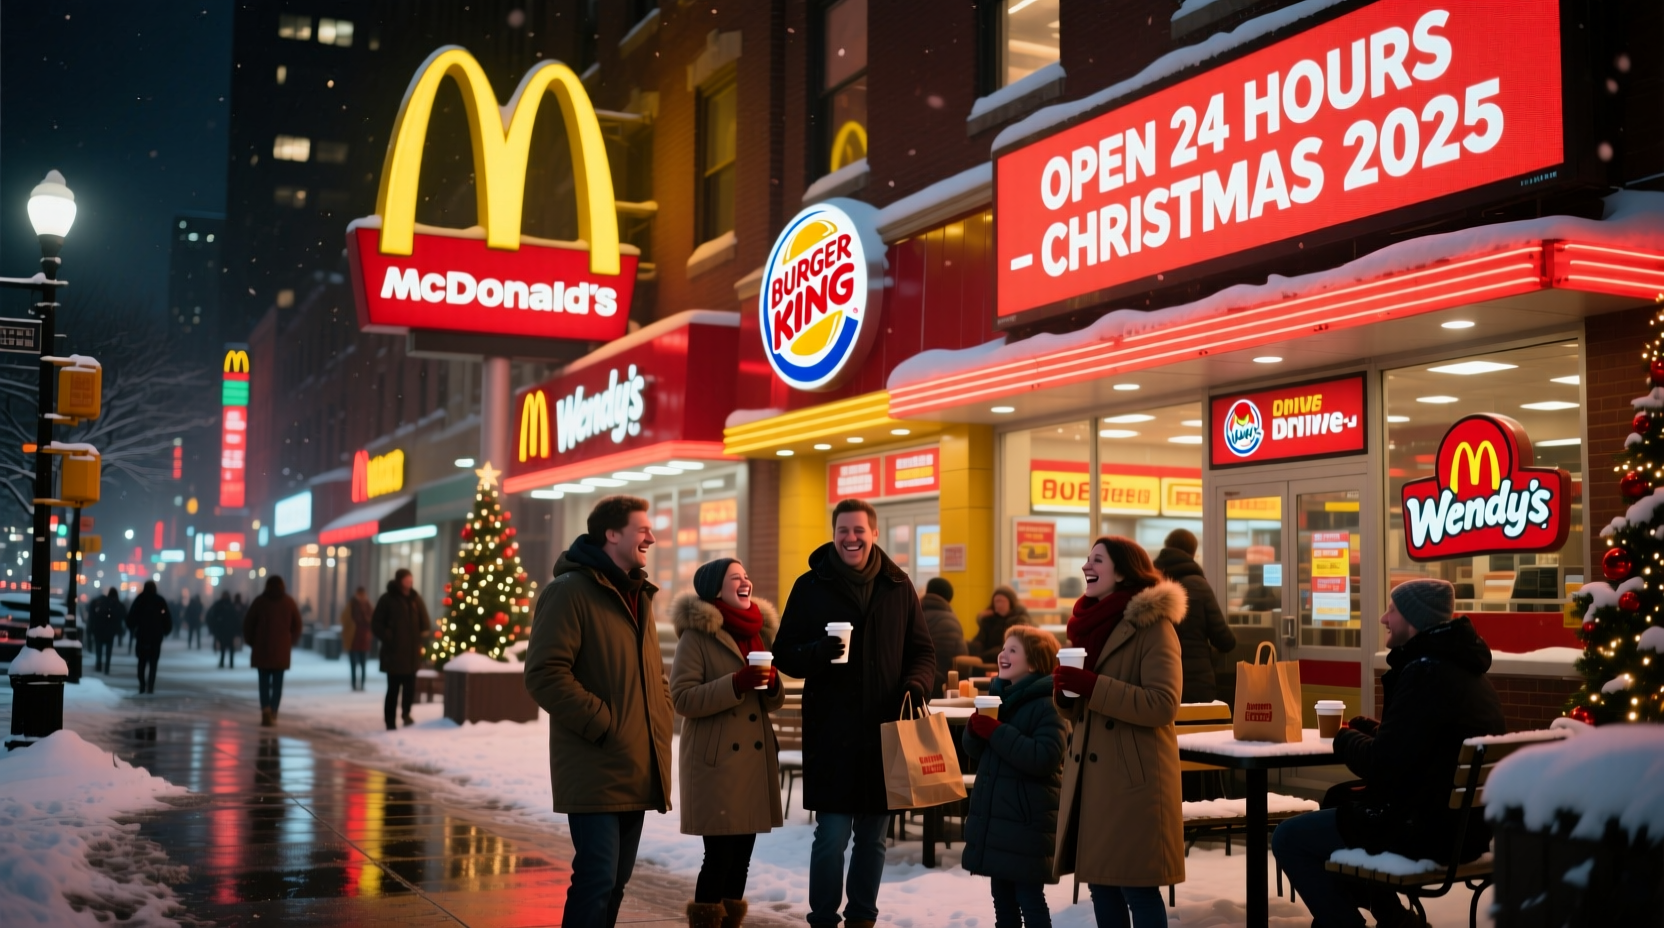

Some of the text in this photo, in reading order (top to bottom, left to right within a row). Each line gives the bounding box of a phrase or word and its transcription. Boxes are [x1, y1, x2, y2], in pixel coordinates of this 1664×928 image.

[1040, 9, 1453, 211] OPEN 24 HOURS
[1041, 136, 1325, 277] CHRISTMAS
[1342, 77, 1504, 192] 2025
[380, 266, 618, 317] McDonald's
[771, 233, 852, 310] BURGER
[774, 262, 855, 351] KING
[1406, 478, 1551, 549] Wendy's
